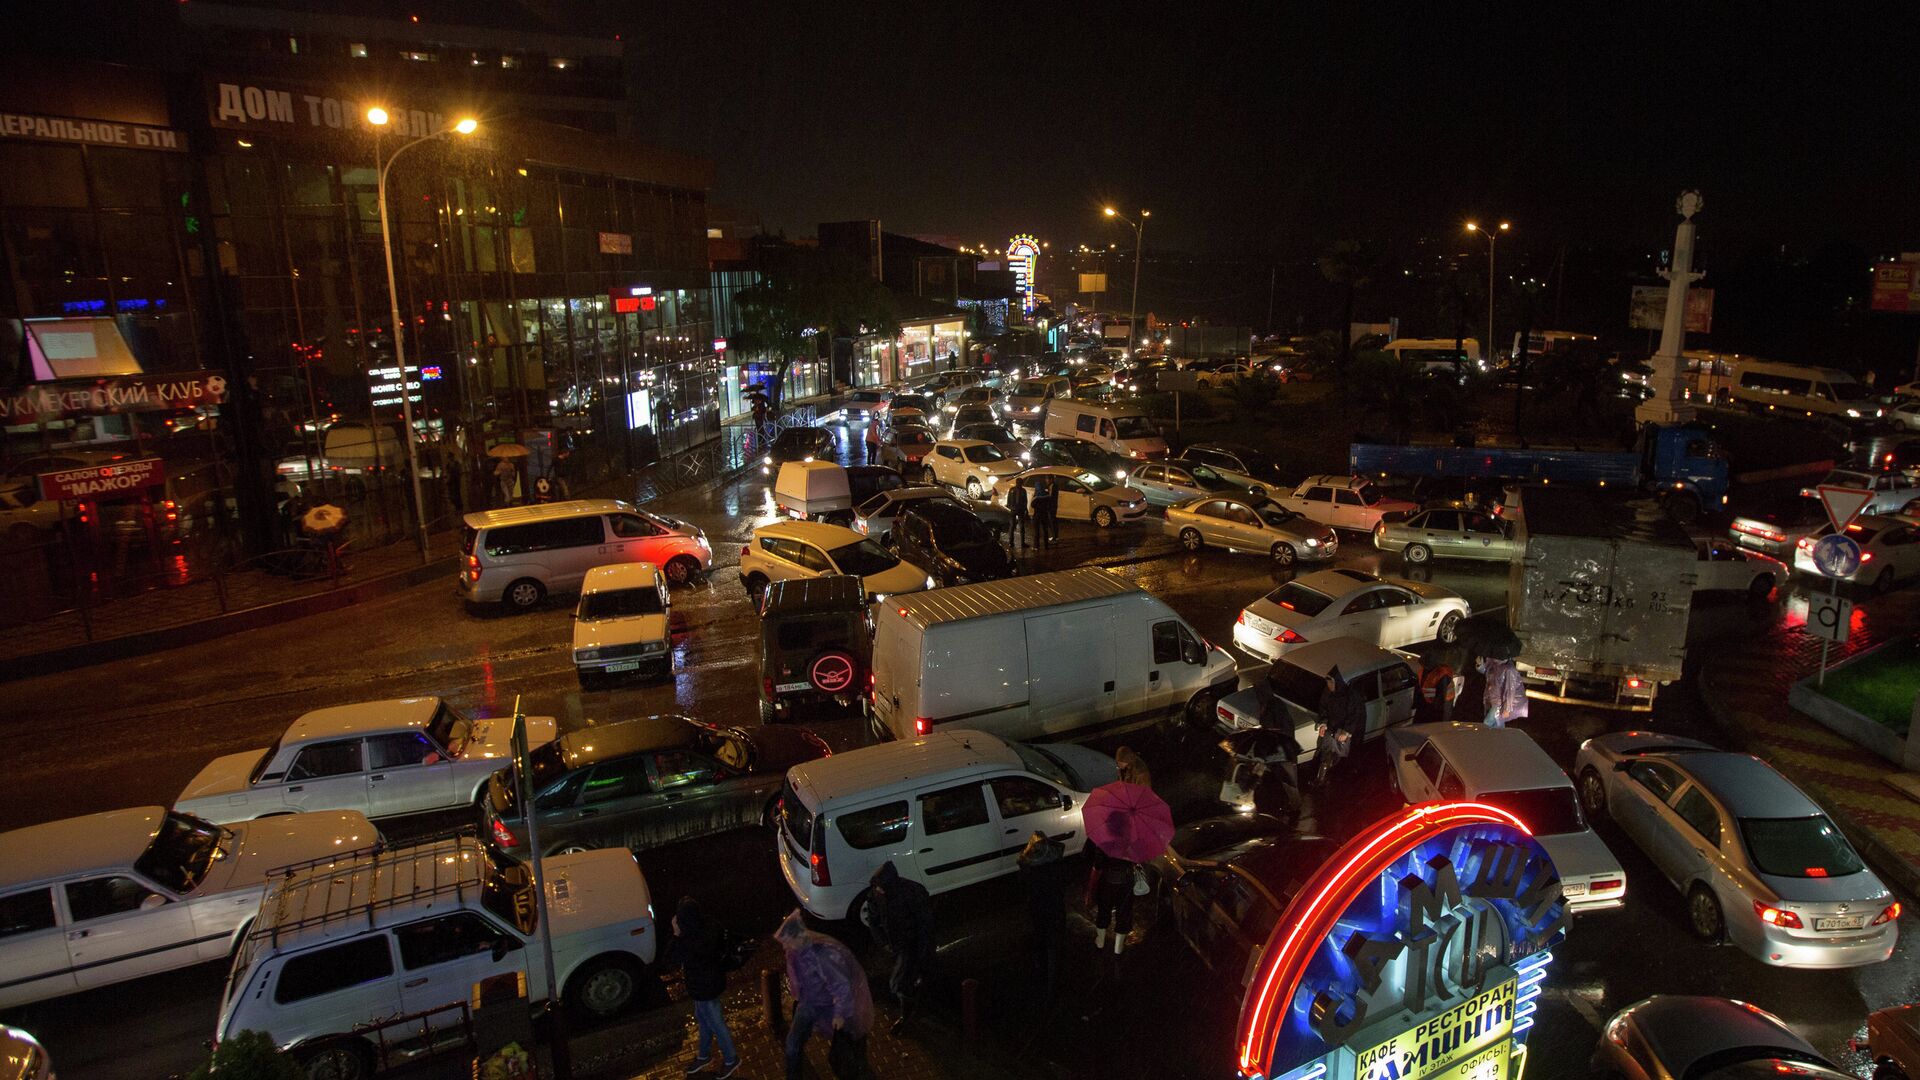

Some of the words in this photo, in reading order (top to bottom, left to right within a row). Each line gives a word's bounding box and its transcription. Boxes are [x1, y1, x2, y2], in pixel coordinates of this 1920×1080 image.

[219, 83, 294, 123] ДОМ
[304, 95, 445, 140] ТОРВЛИ
[134, 127, 177, 148] БТИ
[157, 380, 203, 402] КЛУБ
[396, 381, 420, 391] CRLO
[55, 468, 98, 483] САЛОН
[100, 461, 153, 477] ОДЕЖДЫ
[1360, 1039, 1397, 1071] КАФЕ
[1415, 980, 1516, 1043] РЕСТОРАН
[1430, 1054, 1454, 1071] ЭТАЖ
[1460, 1044, 1508, 1075] ОФИСЫ:
